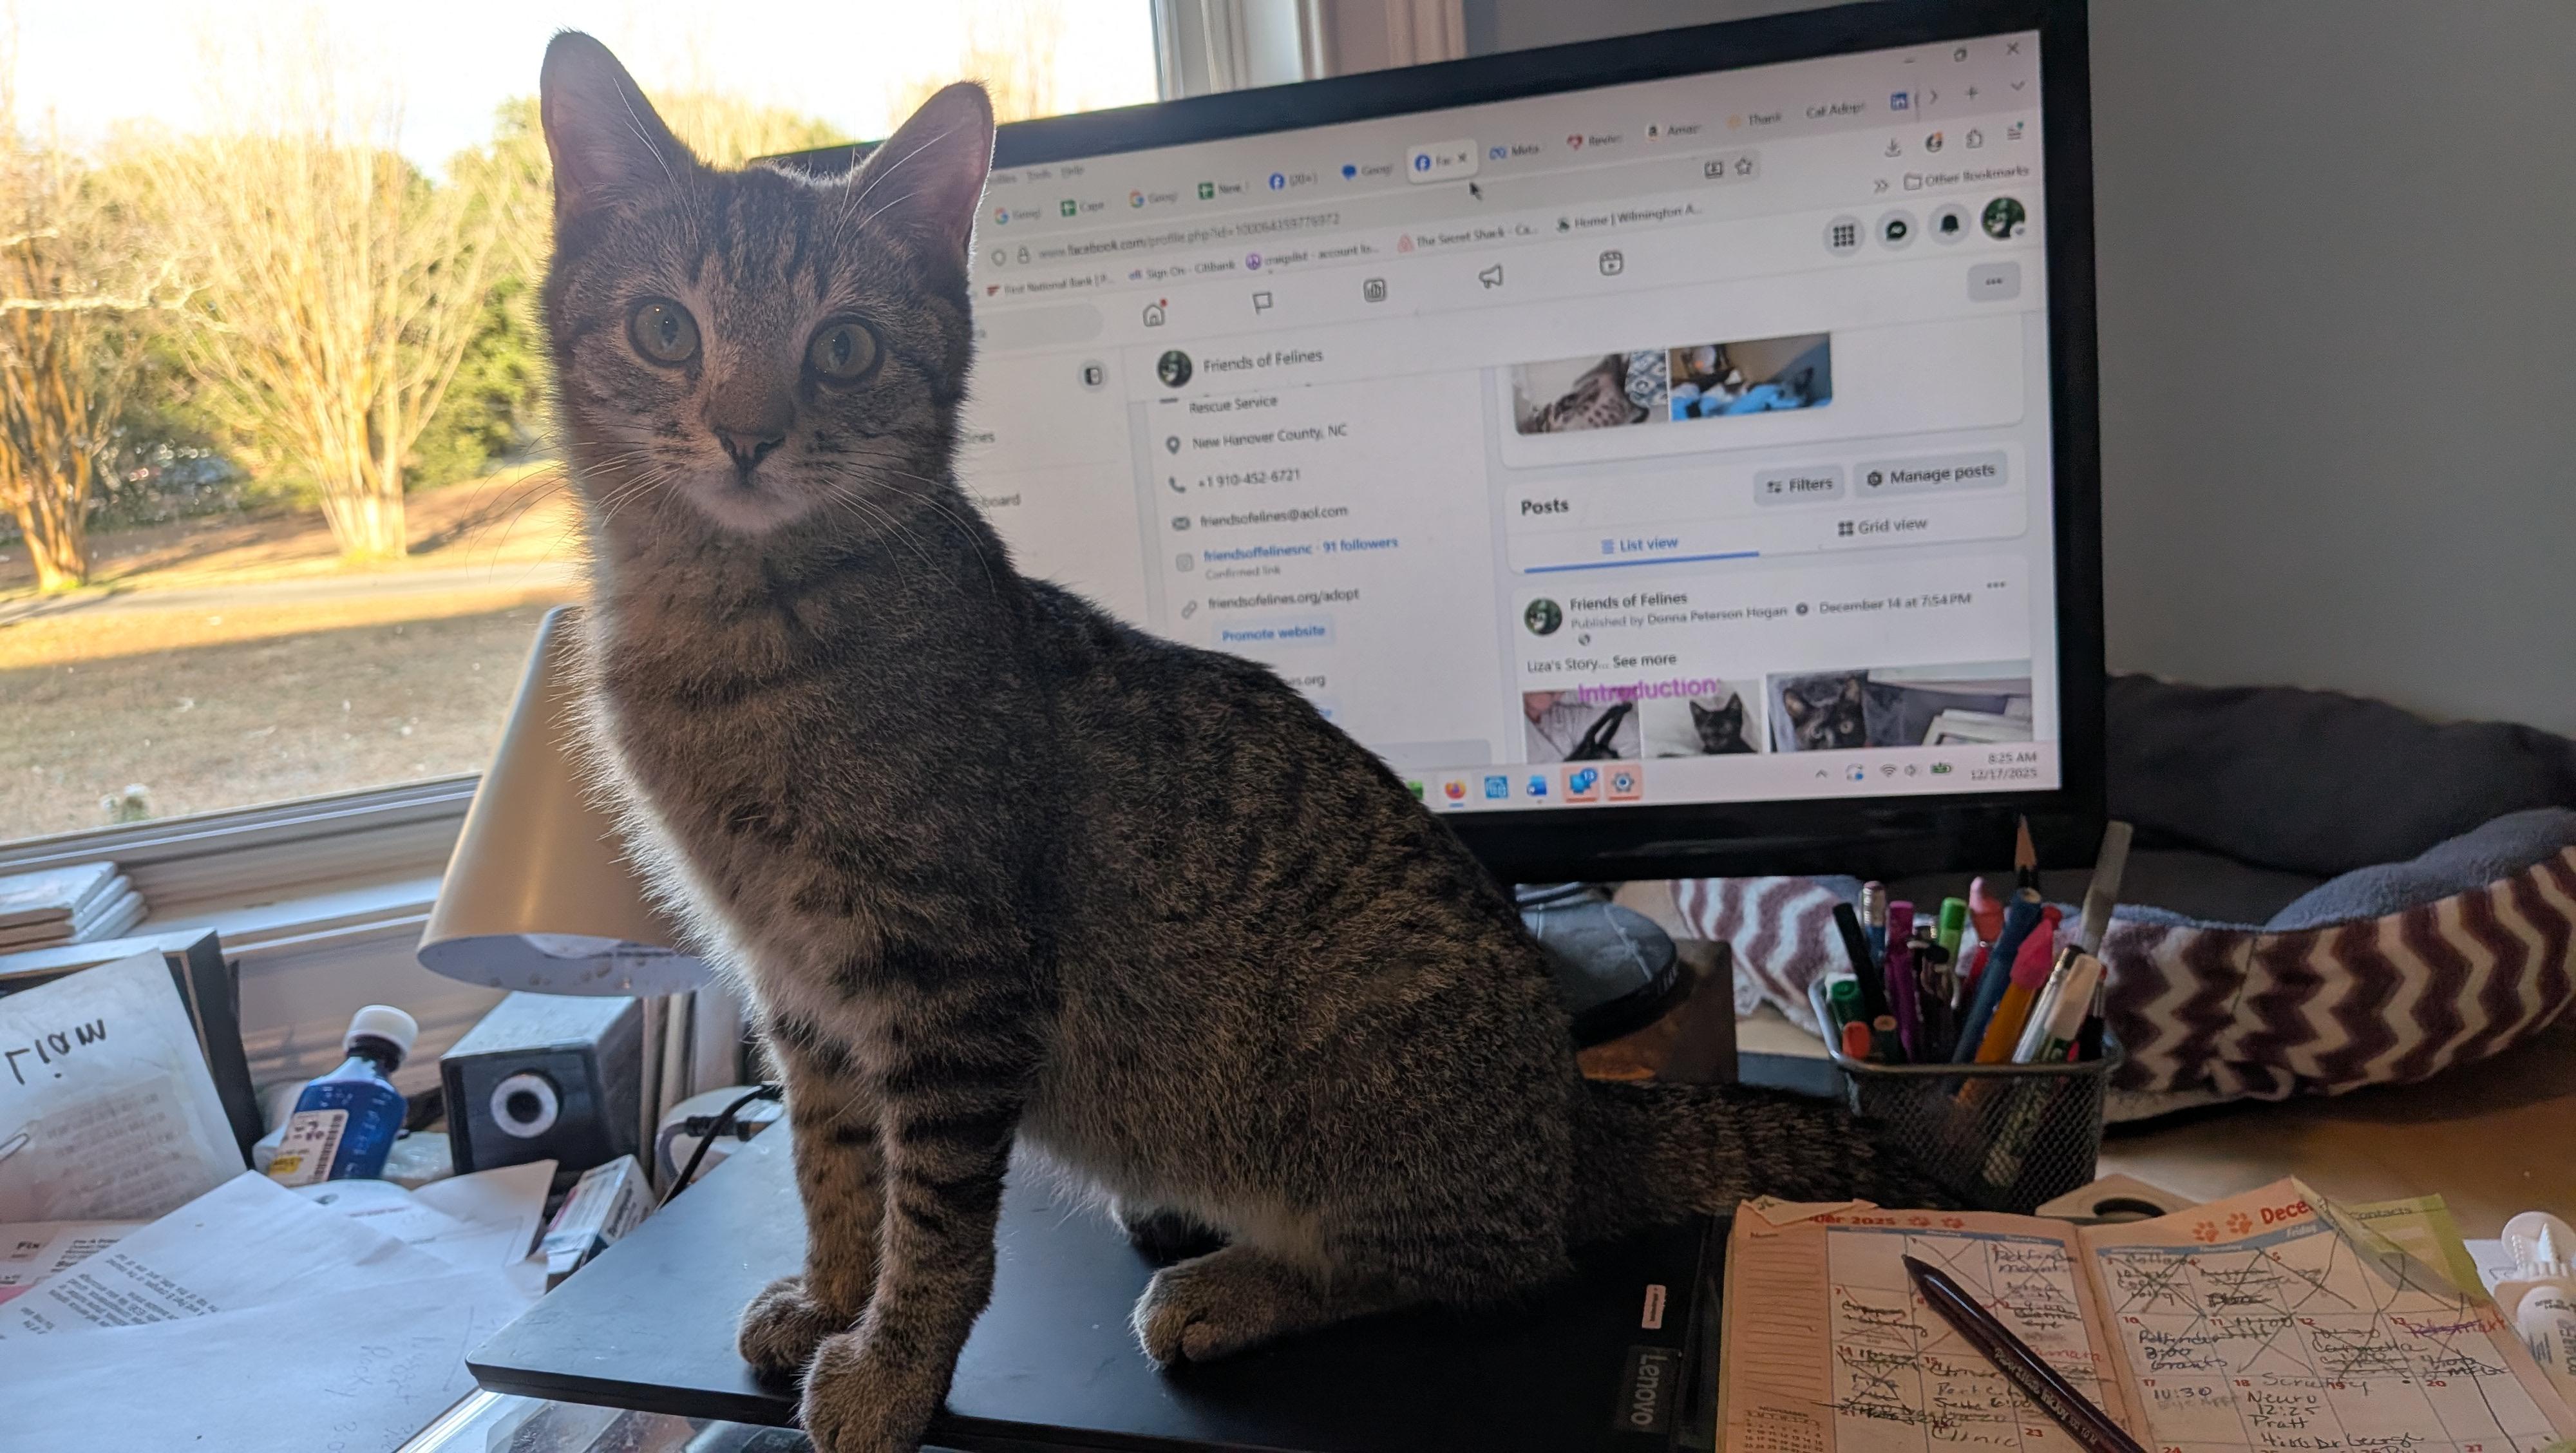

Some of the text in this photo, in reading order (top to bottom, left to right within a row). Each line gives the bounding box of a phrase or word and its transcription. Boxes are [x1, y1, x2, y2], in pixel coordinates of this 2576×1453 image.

[1511, 144, 1539, 156] Meta
[1925, 165, 2030, 186] Other Bookmarks
[1575, 216, 1608, 228] Home
[1618, 207, 1682, 223] Wilmington
[1438, 231, 1471, 246] Secret
[1203, 349, 1324, 374] Friends of Felines
[1189, 395, 1278, 414] Rescue Service
[1192, 423, 1348, 450] New Hanover County, NC
[1216, 468, 1301, 488] 910-452-6721
[1890, 462, 1996, 486] Manage posts
[1789, 477, 1834, 492] Filters
[1520, 499, 1570, 517] Posts
[1858, 517, 1927, 534] Grid view
[1322, 540, 1338, 553] 91
[1340, 536, 1399, 552] followers
[1620, 535, 1679, 553] List view
[1205, 564, 1281, 581] Confirmed link
[1570, 591, 1689, 612] Friends of Felines
[1819, 599, 1884, 614] December
[1888, 596, 1900, 609] 14
[1905, 596, 1918, 607] at
[1571, 606, 1788, 631] Published by Donna Peterson Hogan
[1222, 625, 1326, 643] Promote website
[1526, 659, 1562, 674] Liza's
[1613, 654, 1638, 669] See
[1640, 652, 1677, 667] more
[1987, 750, 2038, 764] 8:25 AM
[1970, 766, 2038, 782] 12/17/2025
[1630, 1354, 1669, 1426] Lenovo
[2025, 1427, 2043, 1438] 23
